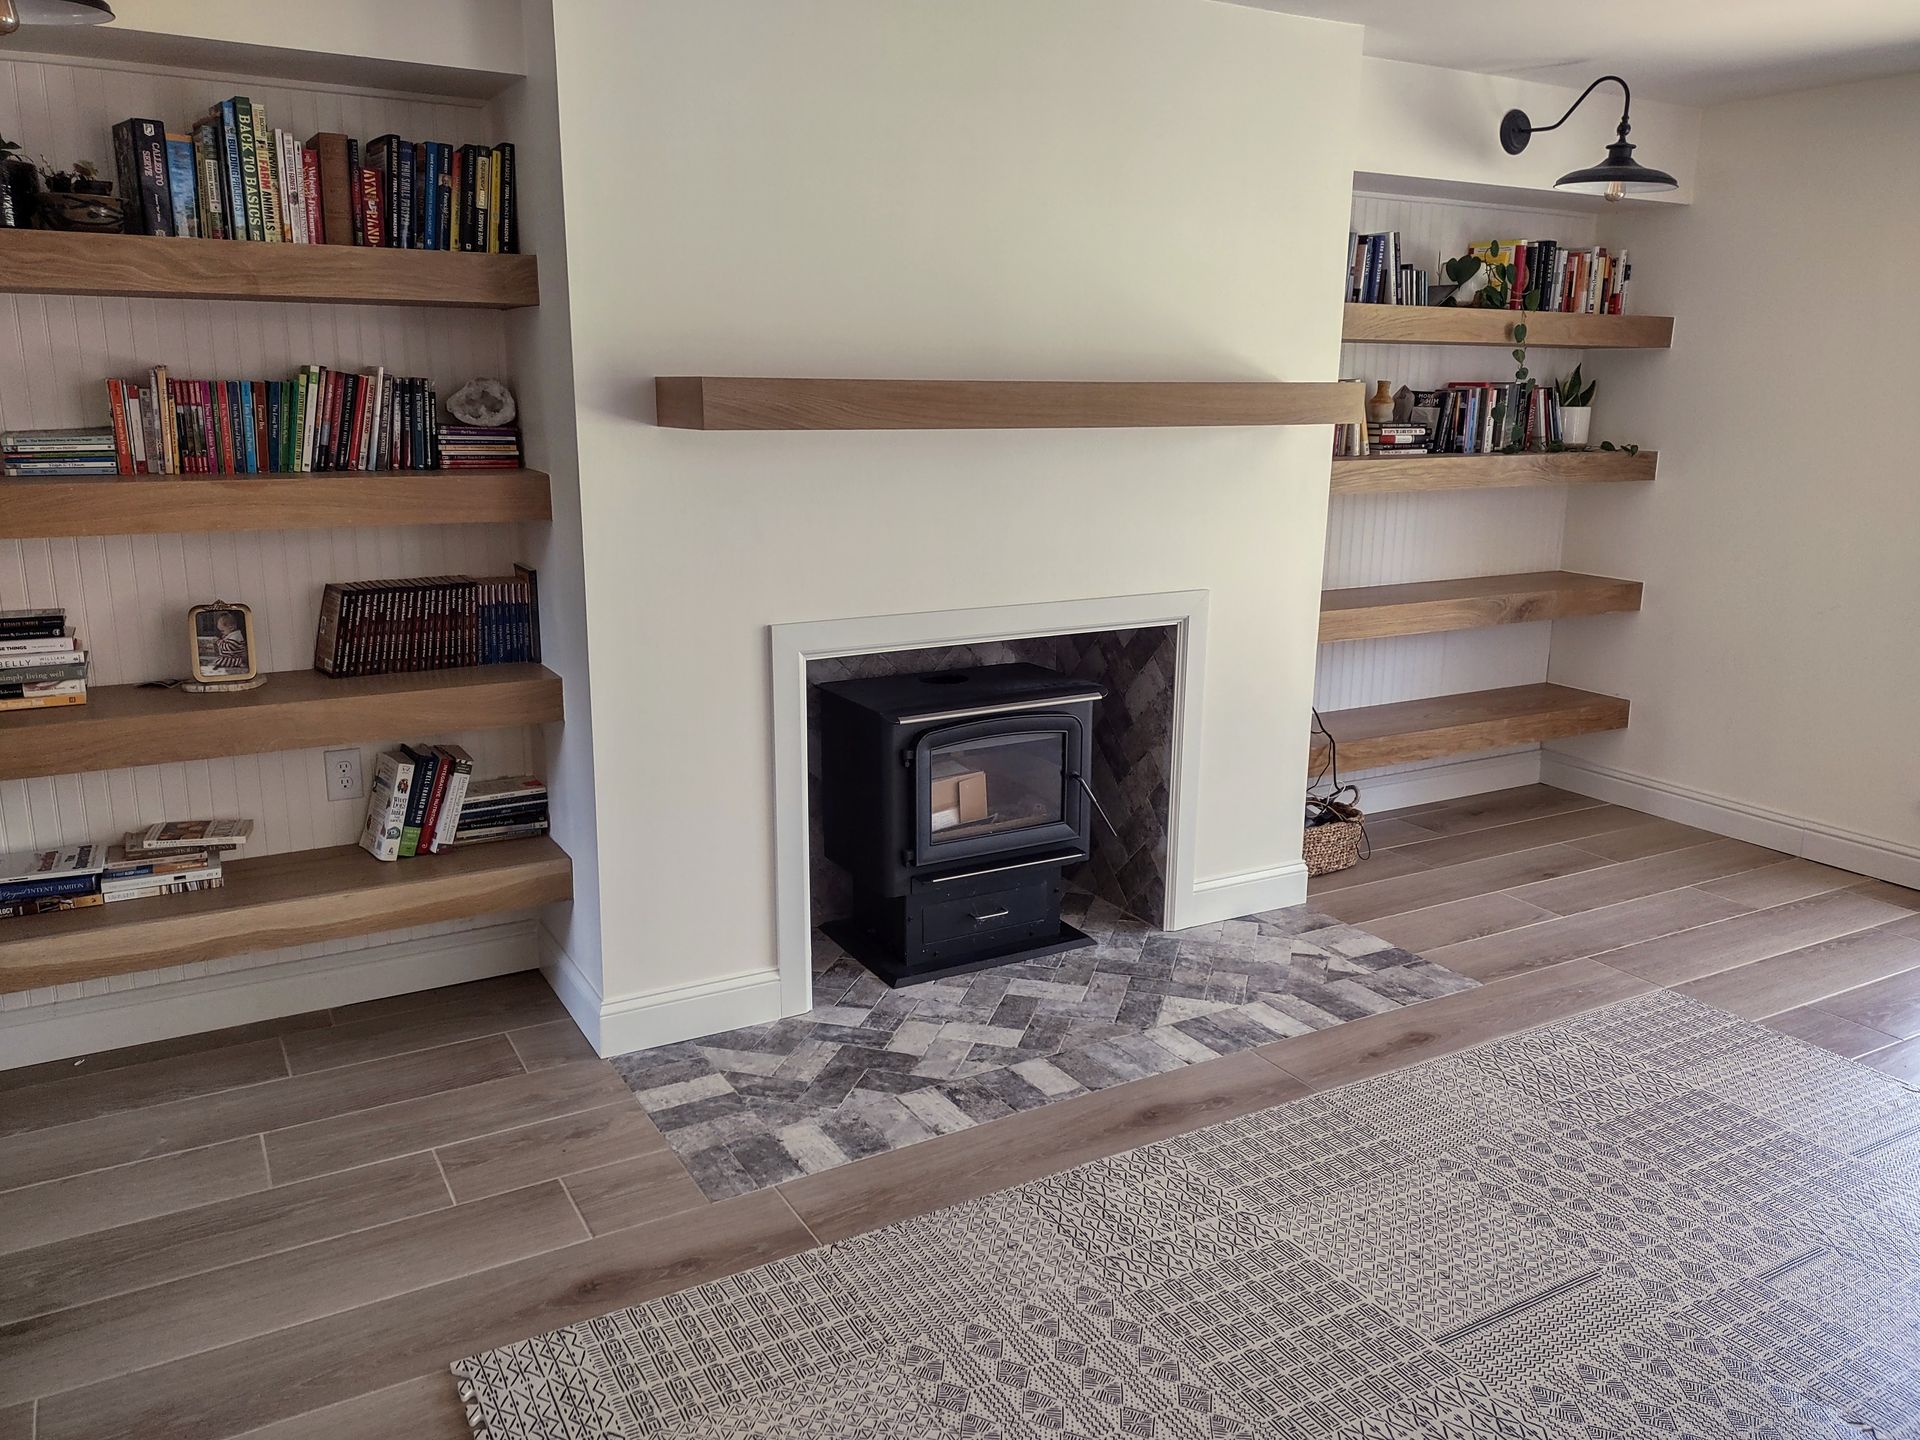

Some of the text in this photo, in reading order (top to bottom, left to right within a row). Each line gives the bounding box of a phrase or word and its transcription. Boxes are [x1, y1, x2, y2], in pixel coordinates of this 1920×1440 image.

[142, 150, 153, 177] SERVE
[152, 143, 165, 186] CALLED TO
[229, 139, 242, 211] BUILDING PROJECTS
[239, 114, 260, 226] BACK TO BASICS
[401, 160, 411, 175] THOU
[259, 160, 276, 231] FARM ANIMALS
[401, 178, 411, 197] SHALL
[363, 170, 380, 243] AYN RAND
[367, 405, 373, 414] WE
[25, 671, 49, 680] living
[49, 669, 65, 677] well
[419, 770, 432, 808] WELL-TRAINED
[428, 764, 448, 826] INTEGRATIVE NUTRITION
[459, 776, 468, 791] Taking
[415, 810, 423, 824] MIND
[27, 886, 53, 894] INTENT
[58, 883, 84, 891] BARTON
